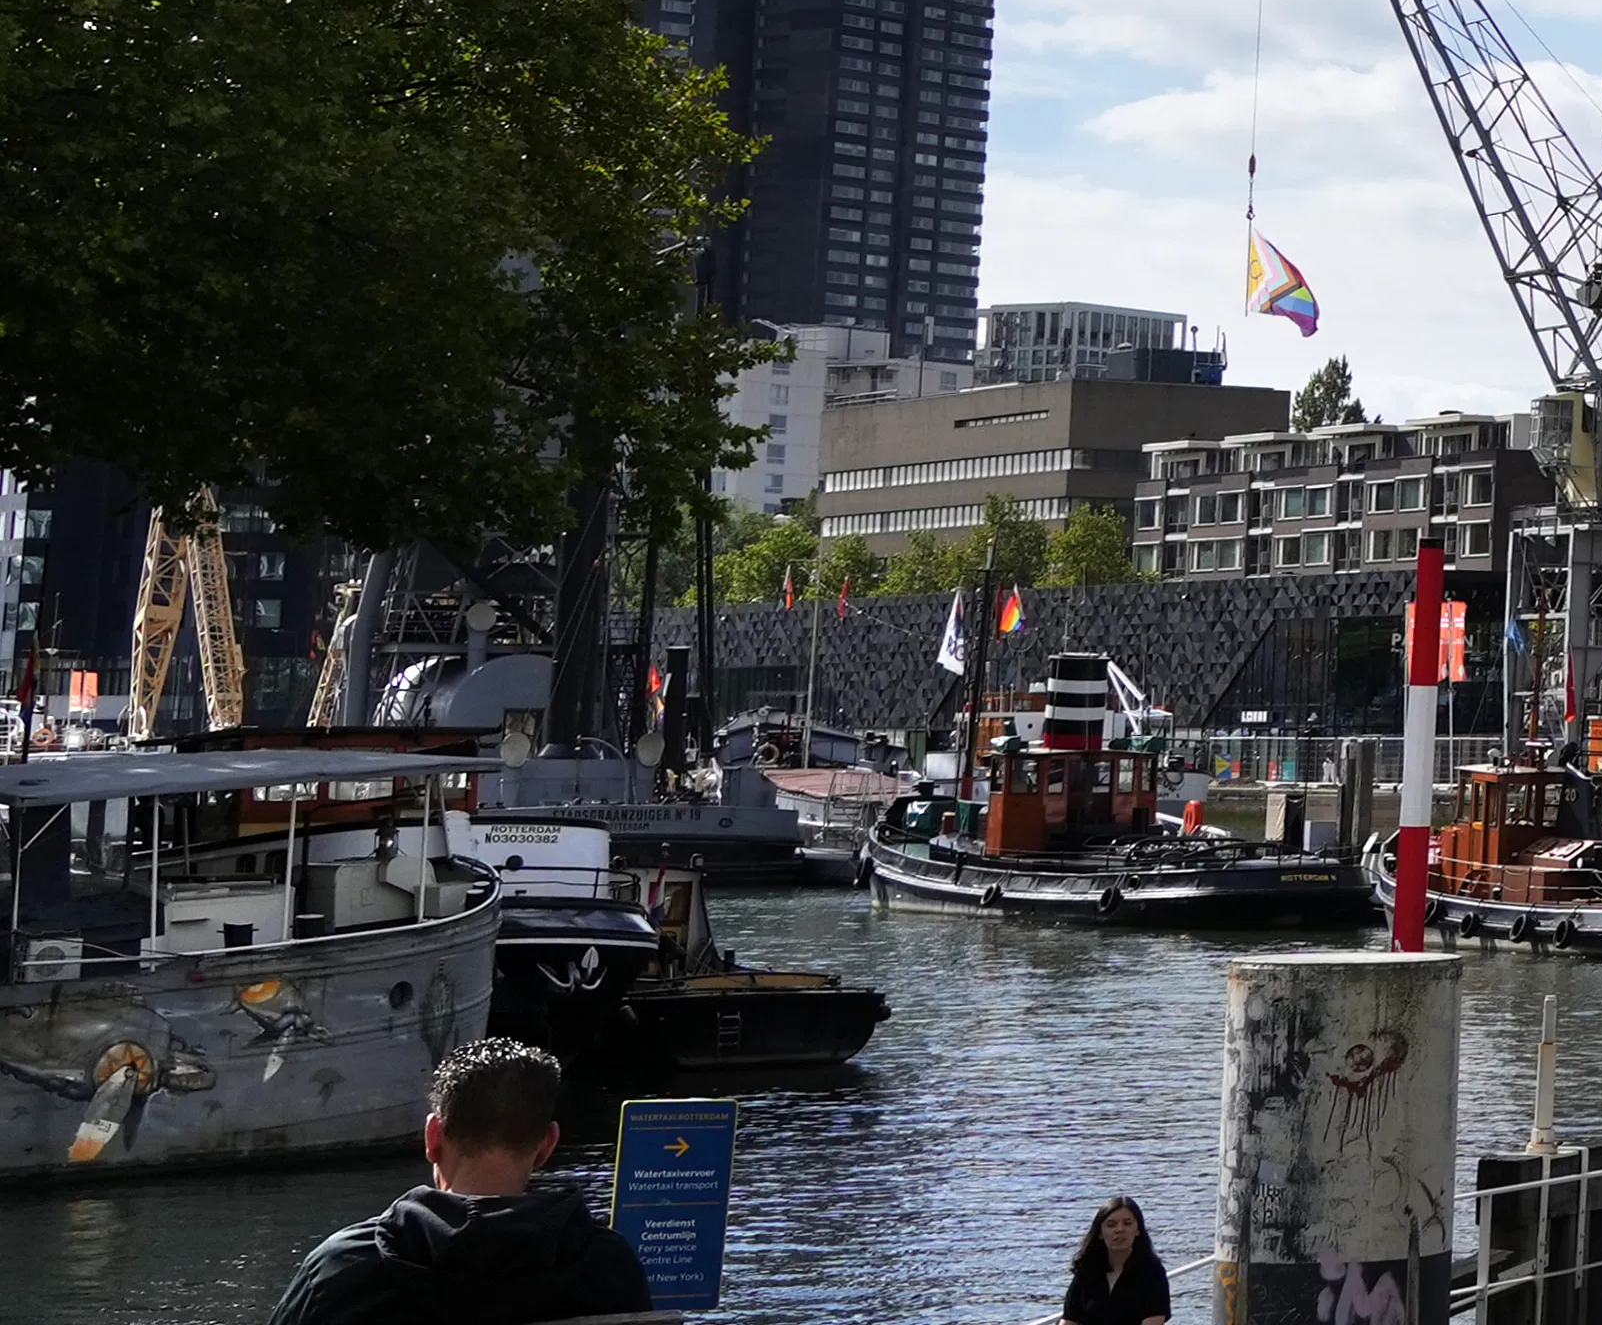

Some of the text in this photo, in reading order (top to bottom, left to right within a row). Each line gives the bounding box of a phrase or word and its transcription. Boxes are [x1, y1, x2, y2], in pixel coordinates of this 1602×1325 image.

[1564, 789, 1576, 801] 20
[490, 825, 561, 834] ROTTERDAM
[630, 1112, 729, 1122] WATERTAXI ROTTERDAM
[634, 1168, 715, 1179] Watertaxivervoer
[629, 1181, 719, 1192] Watertaxi transport
[645, 1219, 696, 1228] Veerdienst
[641, 1231, 697, 1241] Centrumlijn
[638, 1244, 697, 1254] Ferry service
[673, 1255, 693, 1264] Line
[657, 1273, 678, 1282] New
[680, 1272, 704, 1282] York)
